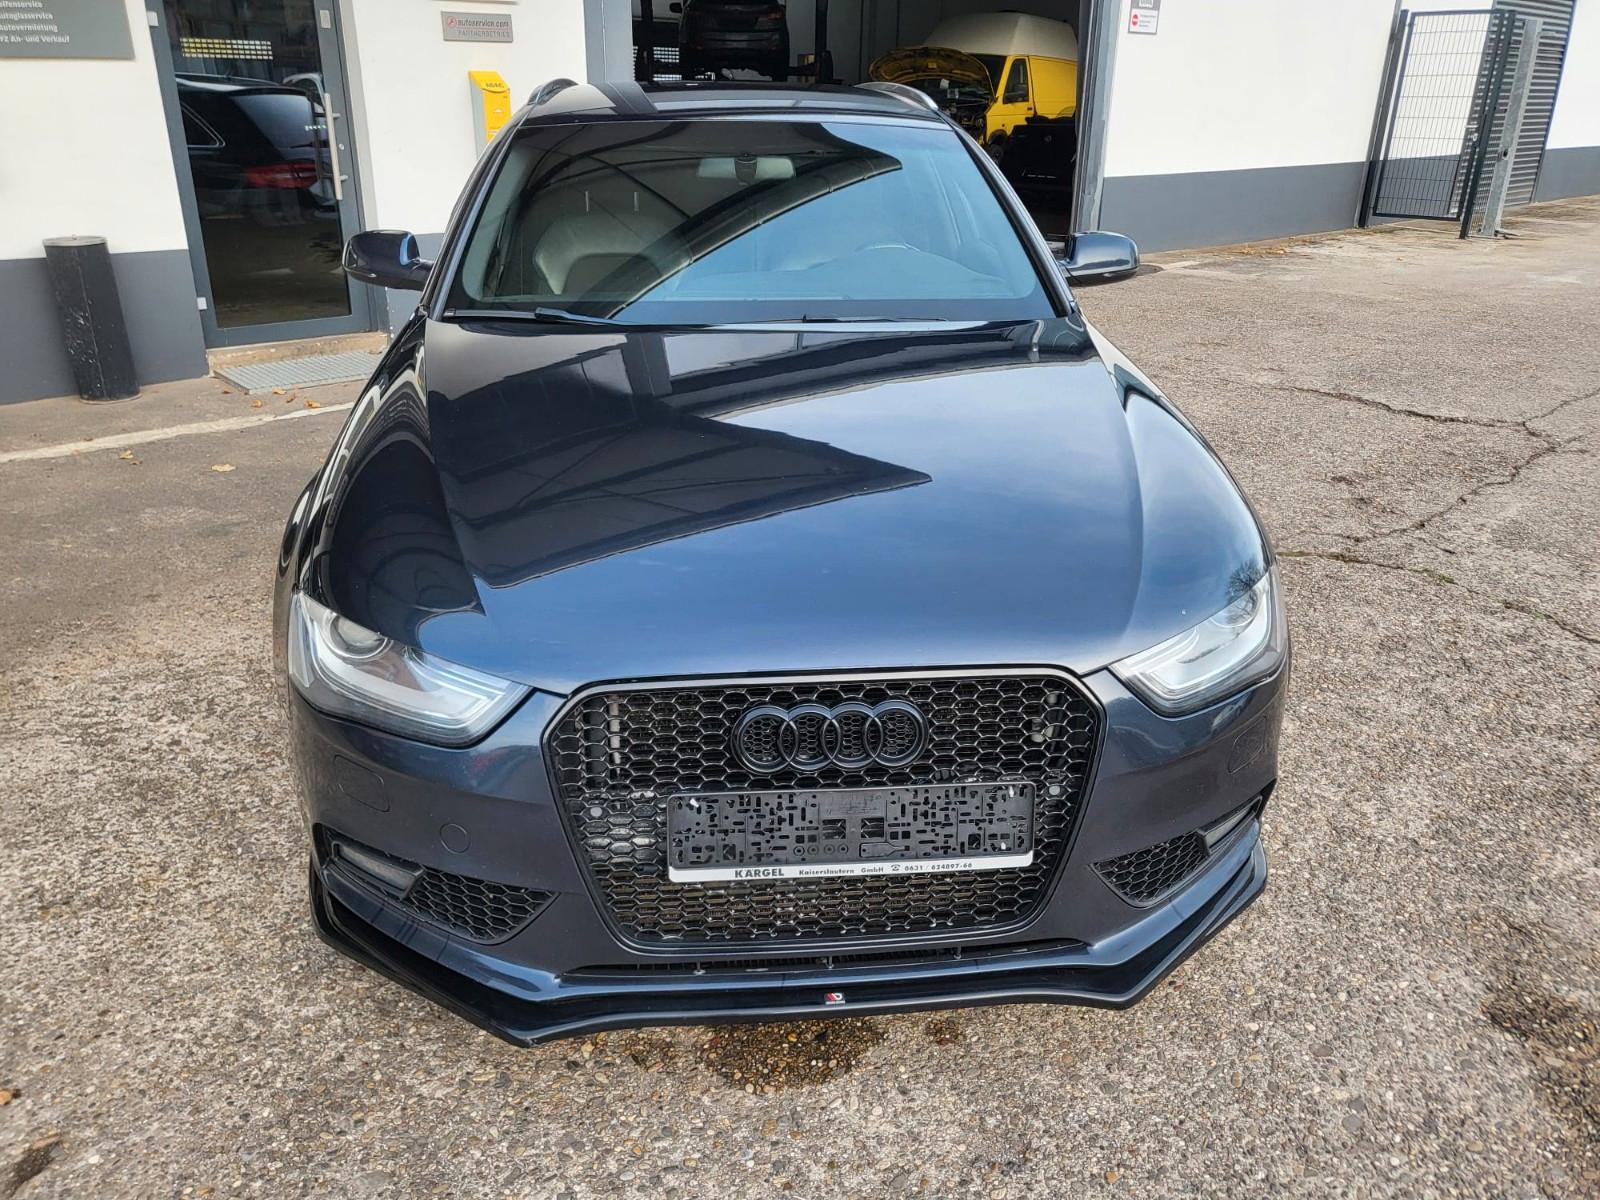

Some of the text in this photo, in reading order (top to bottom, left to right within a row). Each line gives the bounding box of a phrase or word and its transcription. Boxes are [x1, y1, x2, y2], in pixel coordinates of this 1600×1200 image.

[0, 12, 53, 20] utoglasservice
[735, 868, 785, 878] KARGEL
[799, 868, 855, 876] Kaiserslautern
